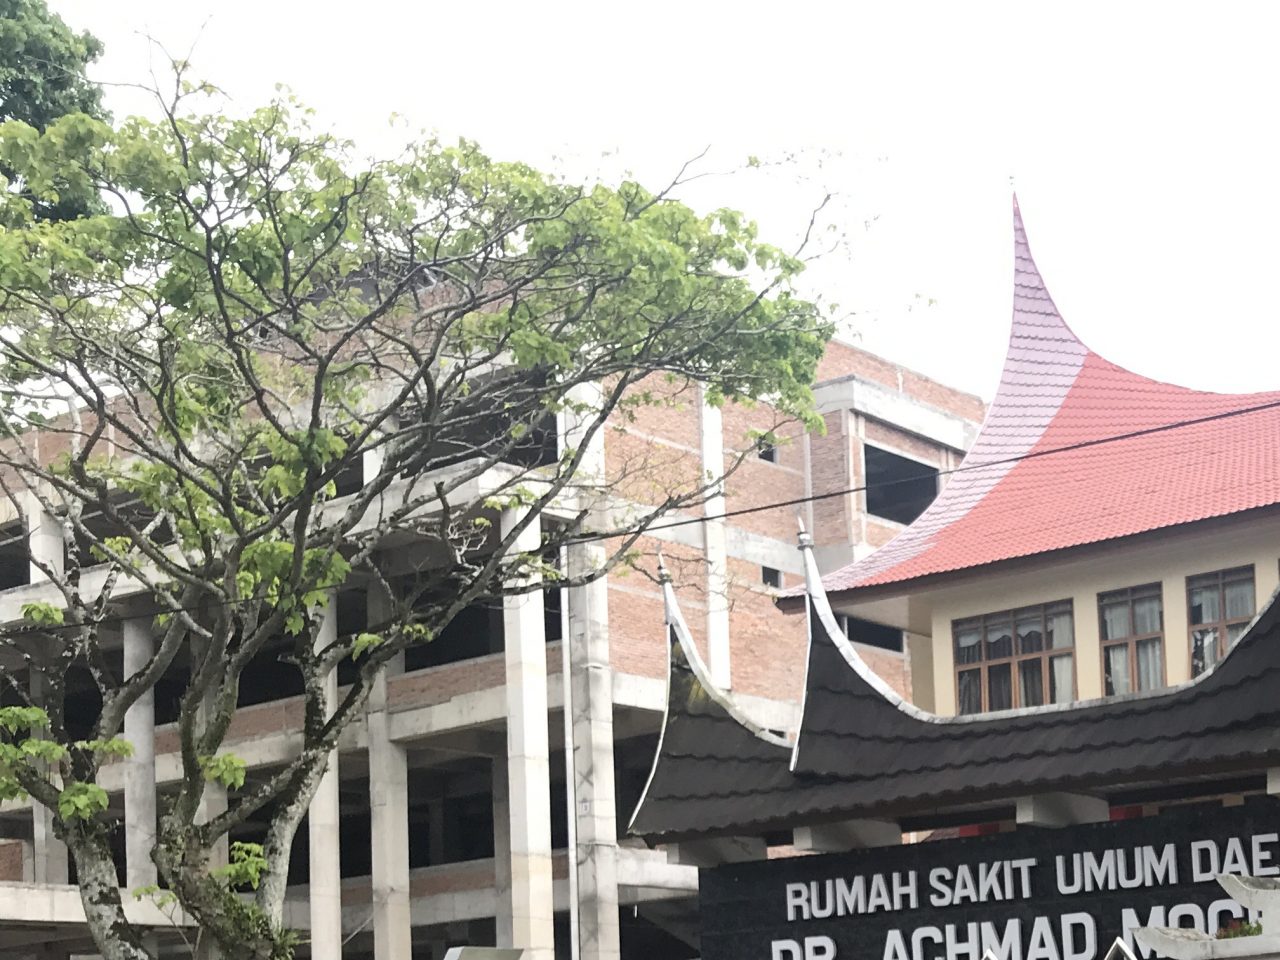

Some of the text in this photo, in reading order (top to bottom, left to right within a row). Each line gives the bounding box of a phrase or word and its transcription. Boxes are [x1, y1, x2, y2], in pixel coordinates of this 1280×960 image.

[786, 870, 918, 922] RUMAH
[929, 857, 1038, 908] SAKIT
[1056, 843, 1178, 896] UMUM
